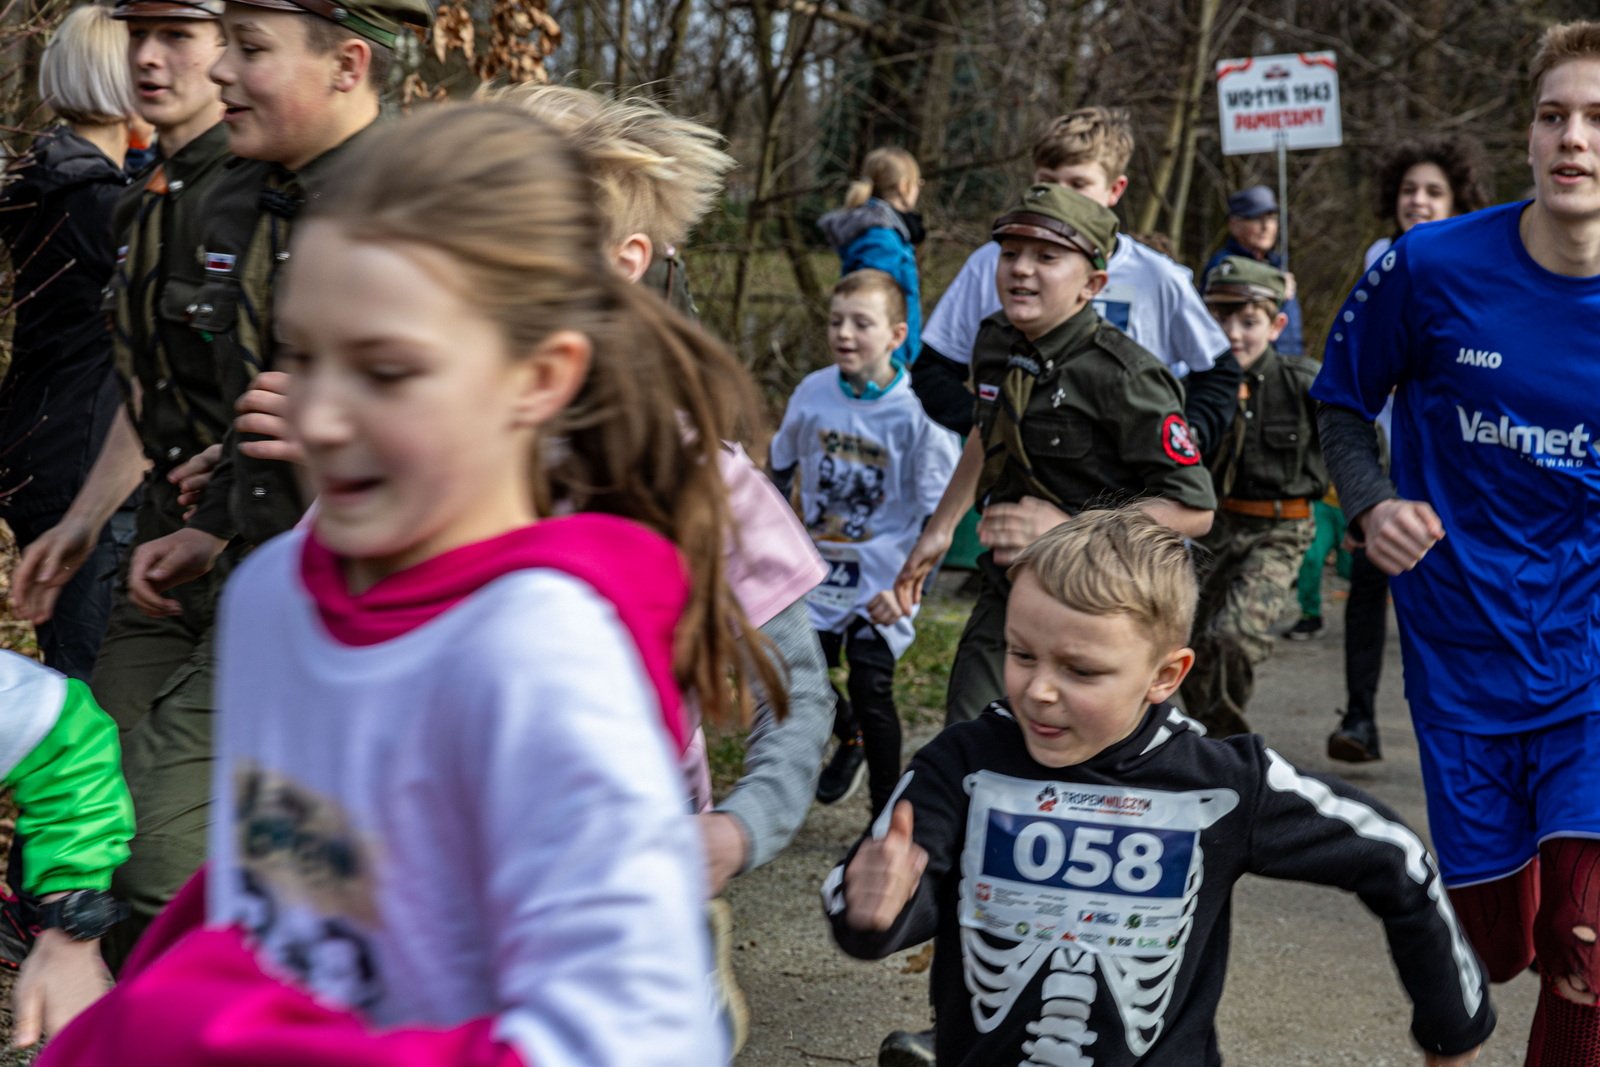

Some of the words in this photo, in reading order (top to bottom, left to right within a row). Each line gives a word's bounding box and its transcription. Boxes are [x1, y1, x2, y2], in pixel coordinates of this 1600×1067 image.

[1294, 82, 1331, 103] 1943
[1456, 347, 1503, 369] JAKO
[1456, 404, 1590, 458] Valmet
[1012, 821, 1165, 893] 058
